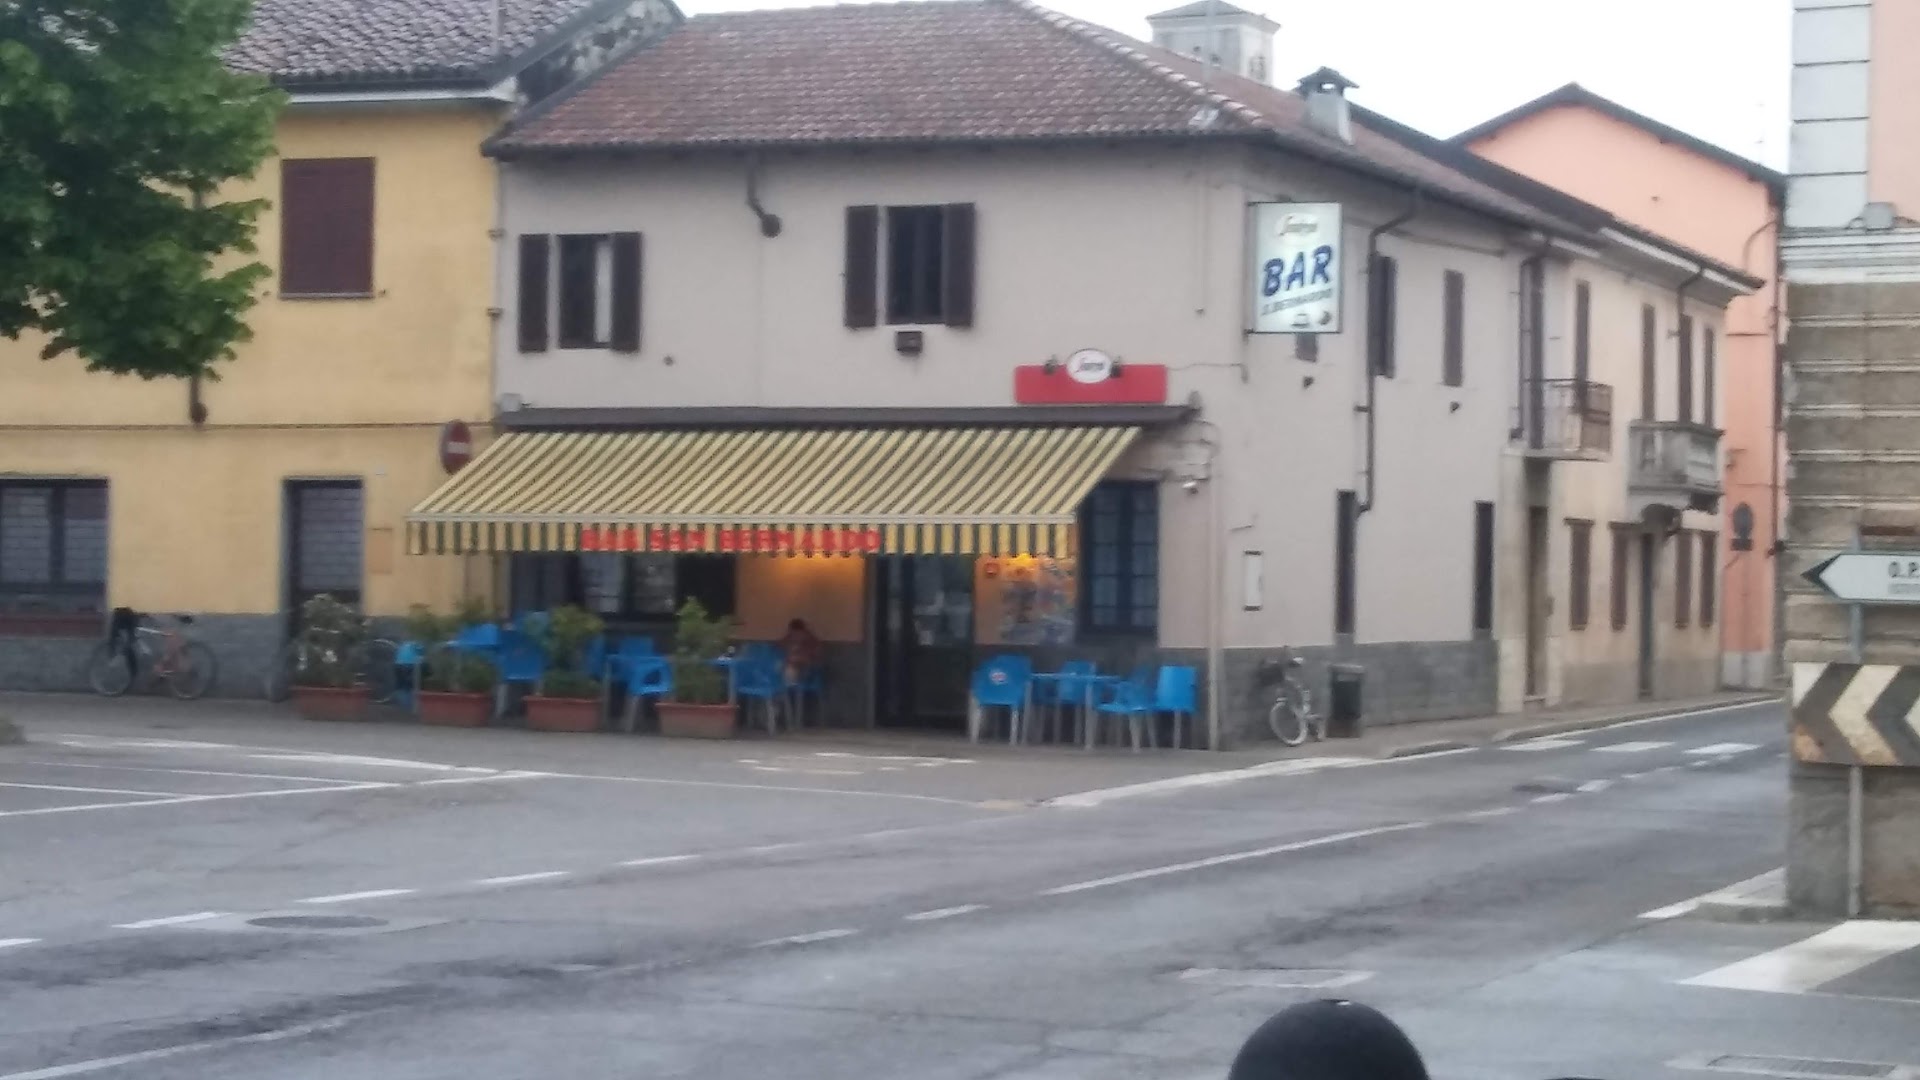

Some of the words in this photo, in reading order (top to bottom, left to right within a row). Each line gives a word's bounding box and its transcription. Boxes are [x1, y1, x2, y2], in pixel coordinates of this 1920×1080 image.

[1263, 245, 1332, 297] BAR
[581, 528, 639, 551] BAR
[650, 528, 706, 551] SAN
[719, 528, 881, 551] BERNARDO
